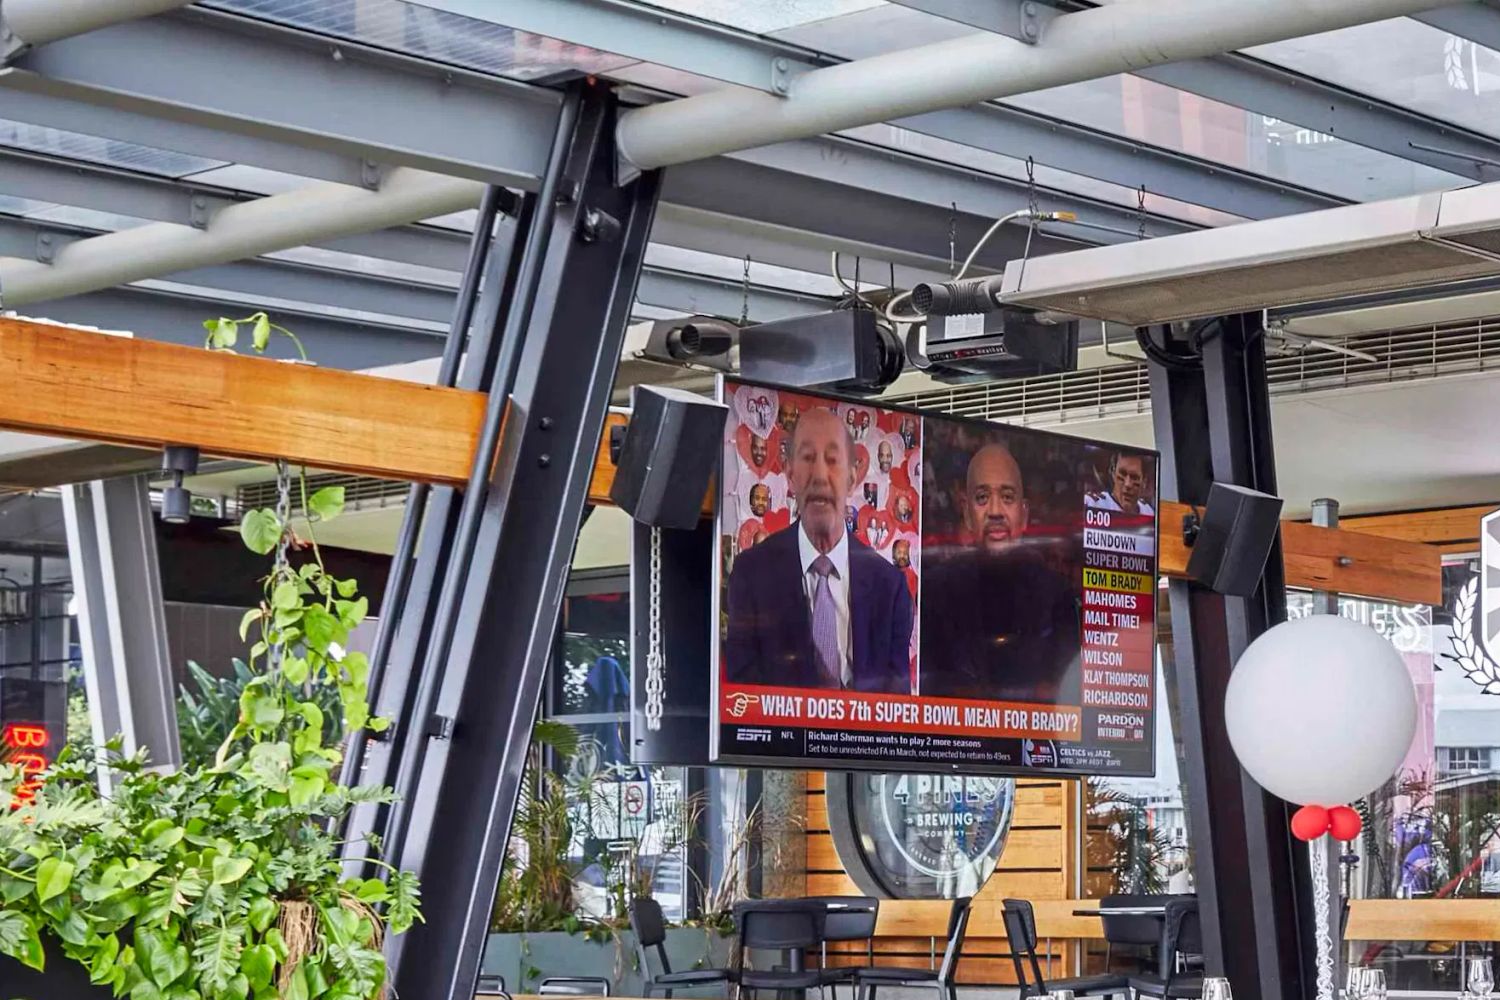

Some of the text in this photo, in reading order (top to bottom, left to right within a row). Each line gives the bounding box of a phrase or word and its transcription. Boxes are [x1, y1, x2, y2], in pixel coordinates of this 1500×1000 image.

[1086, 509, 1111, 527] 0:00
[1086, 531, 1137, 551] RUNDOWN
[1085, 551, 1150, 572] SUPER BOWL
[1085, 571, 1142, 590] TOM BRADY
[1085, 590, 1137, 609] MAHOMES
[1084, 610, 1140, 629] MAIL TIME!
[1084, 630, 1119, 647] WENTZ
[1084, 650, 1122, 667] WILSON
[1084, 669, 1149, 688] KLAY THOMPSON
[1084, 689, 1148, 707] RICHARDSON
[760, 694, 1078, 733] WHAT DOES 7th SUPER BOWL MEAN FOR BRADY?
[1097, 713, 1144, 727] PARDON
[736, 728, 772, 742] ESPN
[781, 731, 795, 739] NFL
[808, 731, 982, 748] Richard Sherman wants to play 2 more seasons
[808, 744, 820, 753] Set
[821, 745, 829, 753] to
[829, 745, 838, 754] be
[839, 745, 879, 755] unrestricted
[880, 747, 889, 756] FA
[889, 747, 895, 756] in
[918, 749, 929, 758] not
[930, 750, 959, 760] expected
[959, 751, 966, 759] to
[967, 752, 986, 760] return
[986, 752, 993, 760] to
[993, 752, 1011, 761] 49ers
[1060, 748, 1086, 757] CELTICS
[1095, 750, 1112, 758] JAZZ
[893, 774, 910, 804] 4
[916, 812, 974, 827] BREWING
